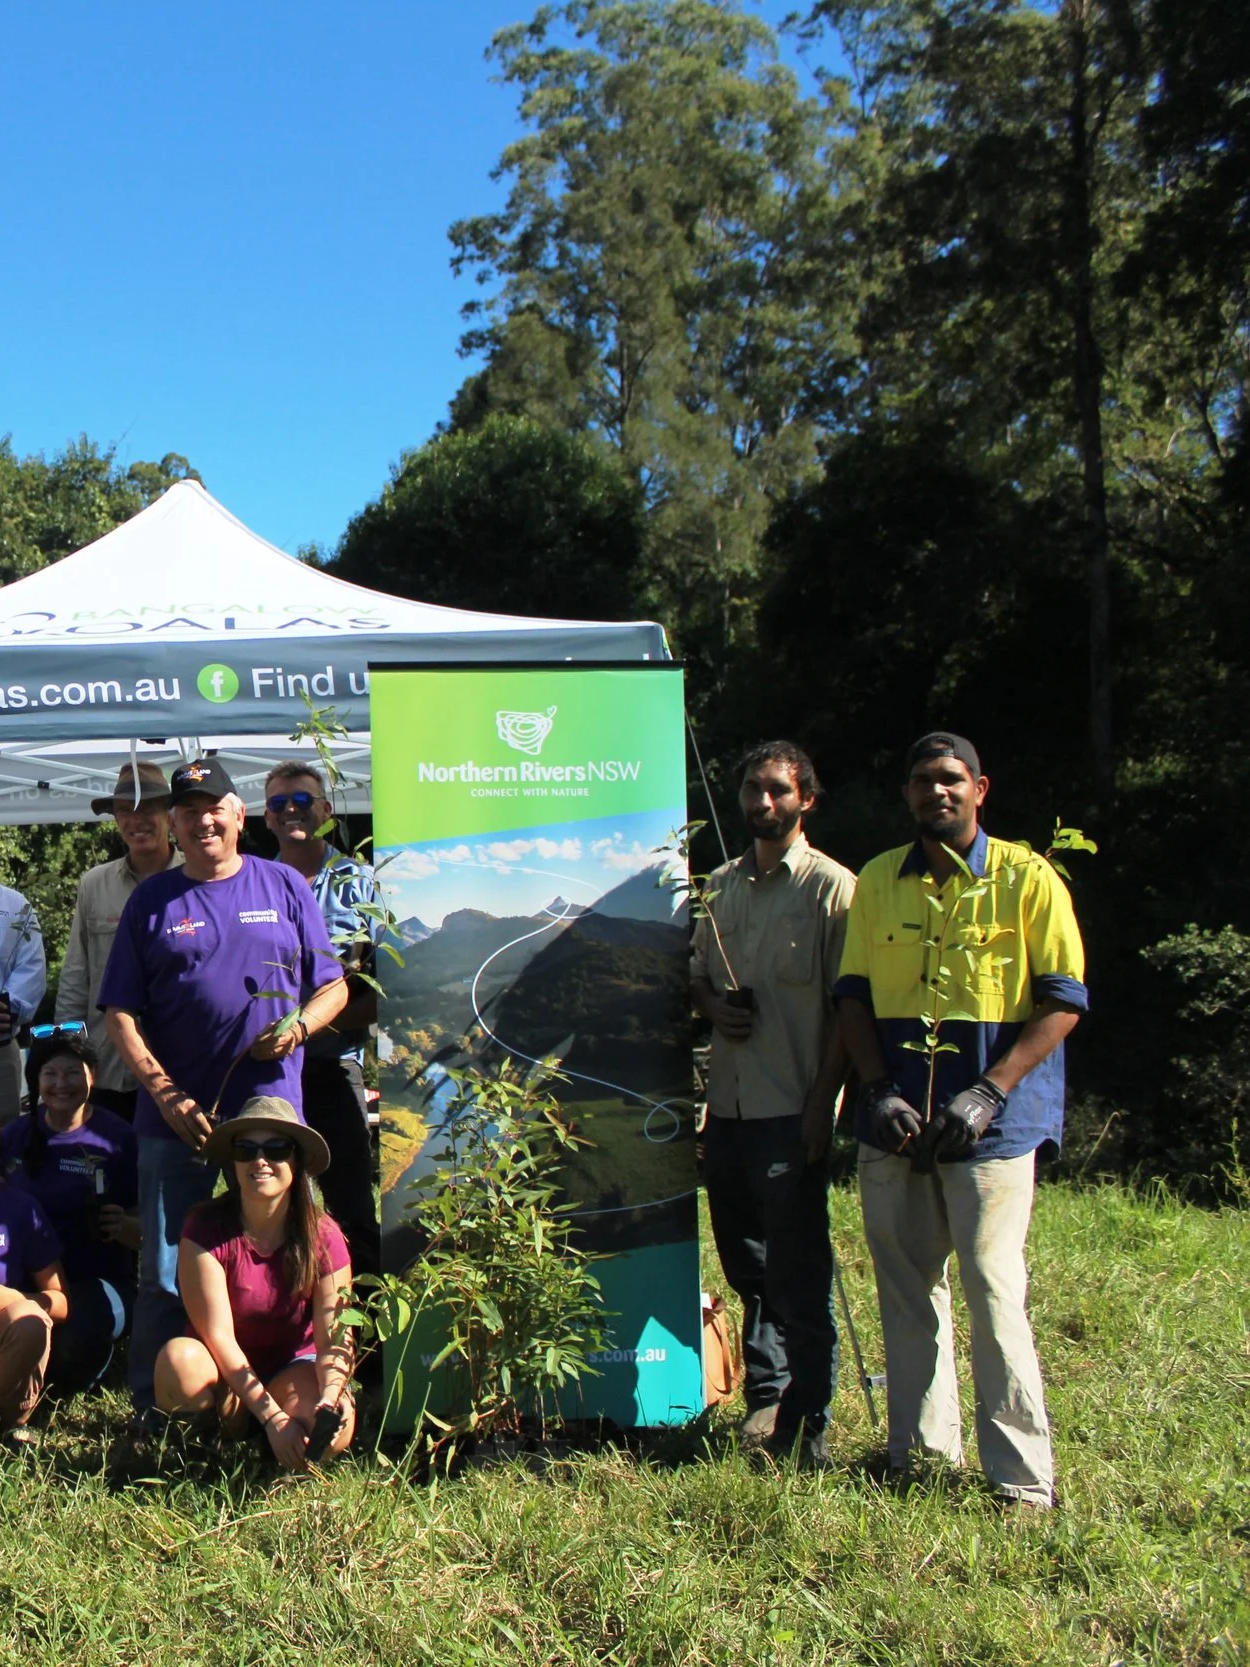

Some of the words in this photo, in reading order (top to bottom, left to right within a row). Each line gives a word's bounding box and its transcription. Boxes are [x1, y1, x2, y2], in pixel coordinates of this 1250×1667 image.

[252, 666, 335, 698] Find
[418, 760, 517, 783] Northern
[470, 788, 519, 797] CONNECT
[523, 788, 548, 797] WITH
[551, 788, 589, 797] NATURE
